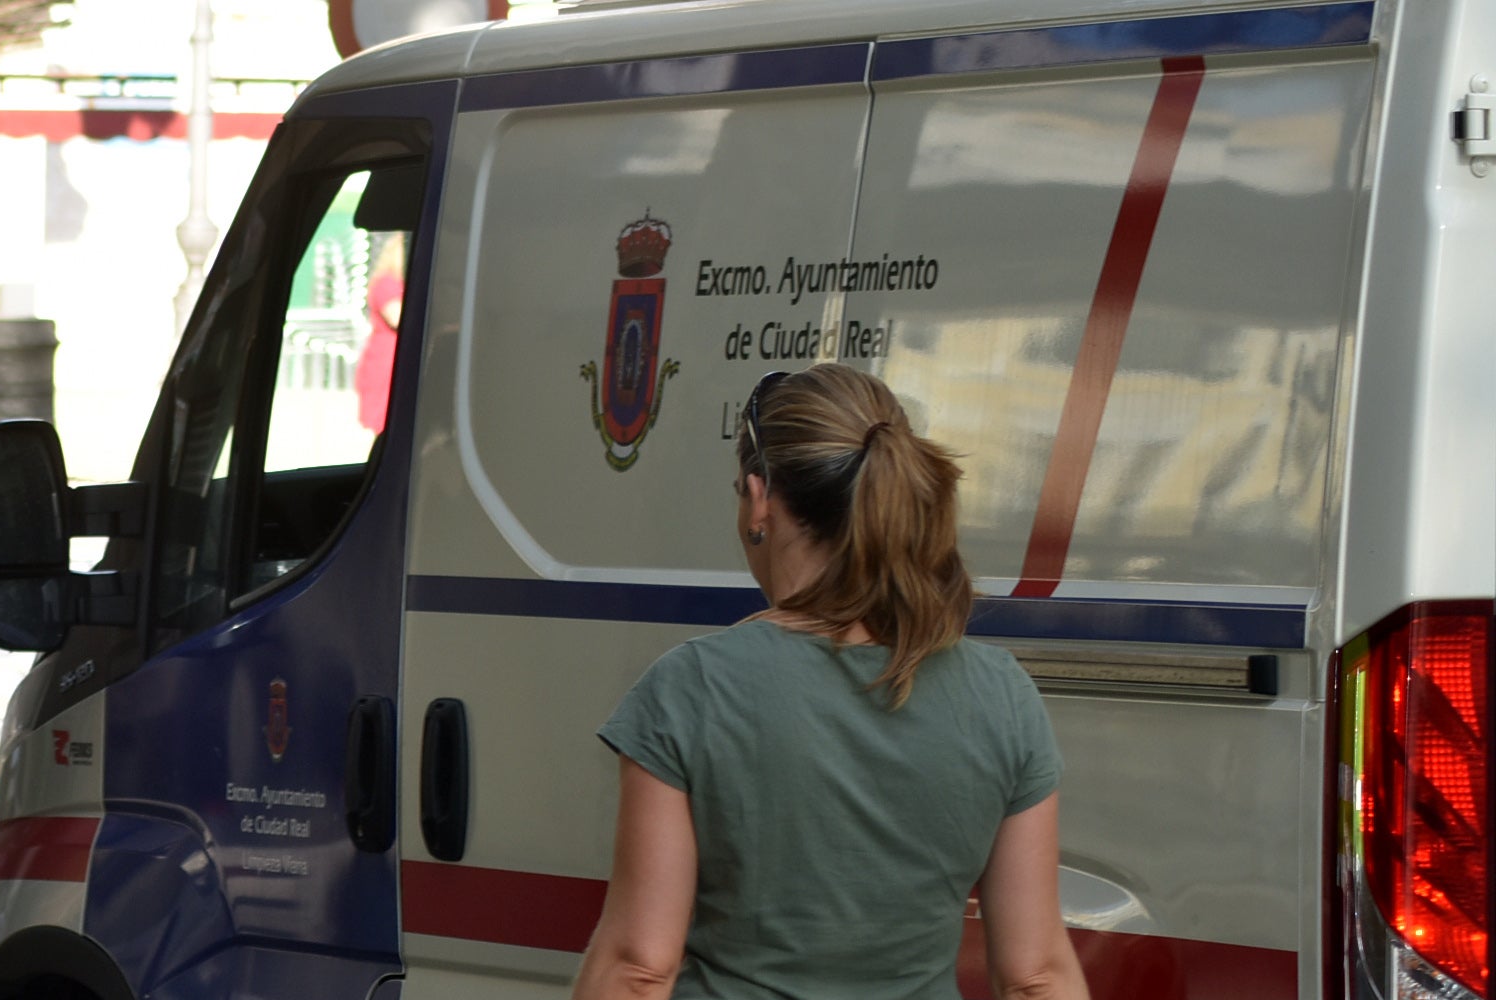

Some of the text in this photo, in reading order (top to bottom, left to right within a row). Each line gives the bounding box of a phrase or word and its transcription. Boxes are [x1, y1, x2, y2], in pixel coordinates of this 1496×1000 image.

[695, 253, 939, 305] Excmo. Ayuntamiento
[725, 320, 893, 360] de Ciudad Real
[261, 786, 326, 809] Ayuntamiento
[240, 816, 311, 837] de Ciudad Real
